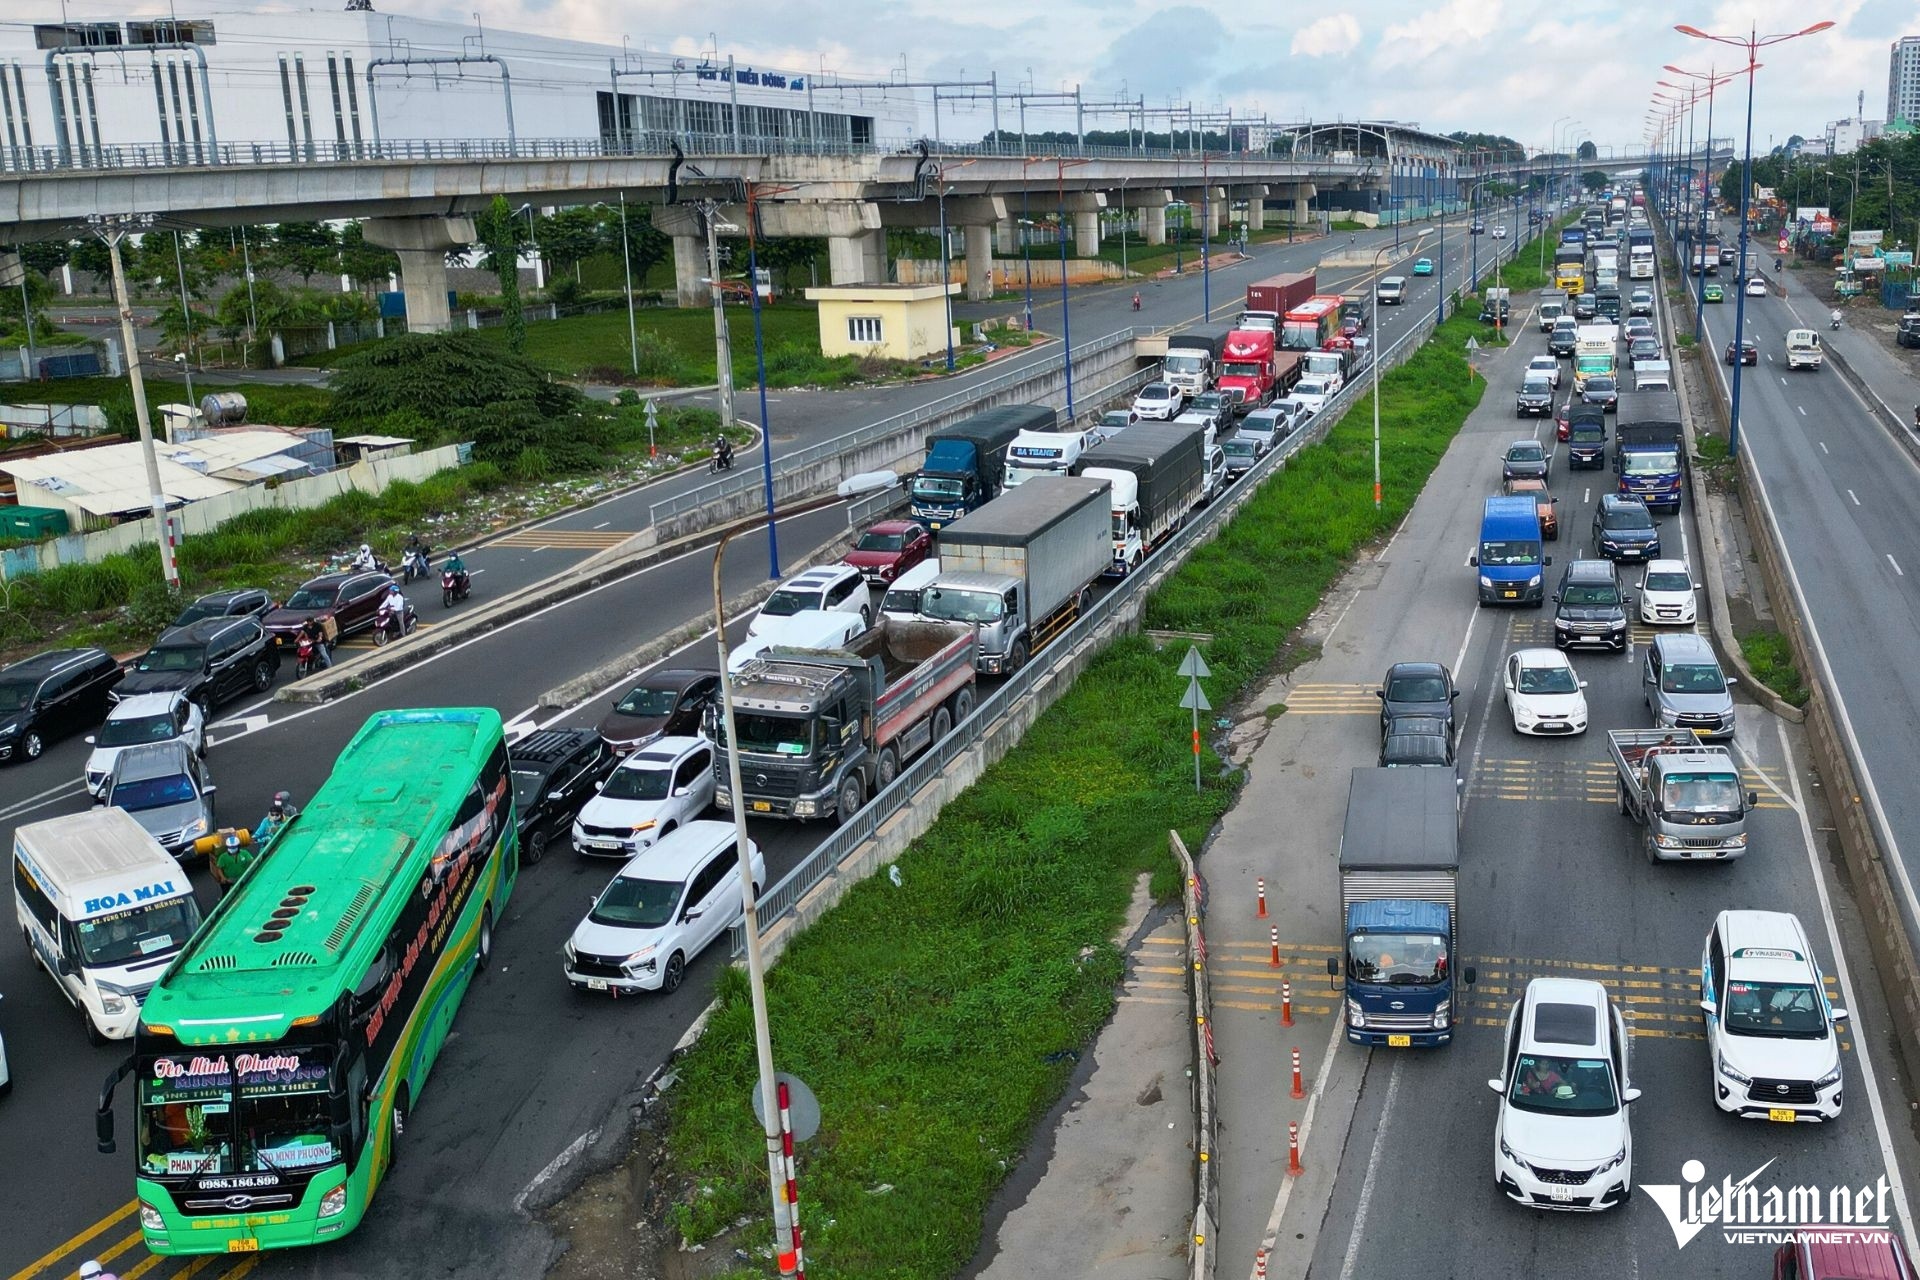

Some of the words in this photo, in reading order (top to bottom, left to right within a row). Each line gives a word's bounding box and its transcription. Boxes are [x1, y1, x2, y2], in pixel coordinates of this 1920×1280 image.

[761, 72, 787, 89] ĐÔNG
[84, 892, 132, 914] HOA
[133, 881, 175, 901] MAI
[1755, 950, 1781, 958] VINASUN
[184, 1055, 230, 1076] Minh
[235, 1053, 300, 1076] Phượng
[241, 1085, 278, 1094] PHAN
[171, 1160, 192, 1172] PHAN
[199, 1176, 279, 1189] 0988.186.899
